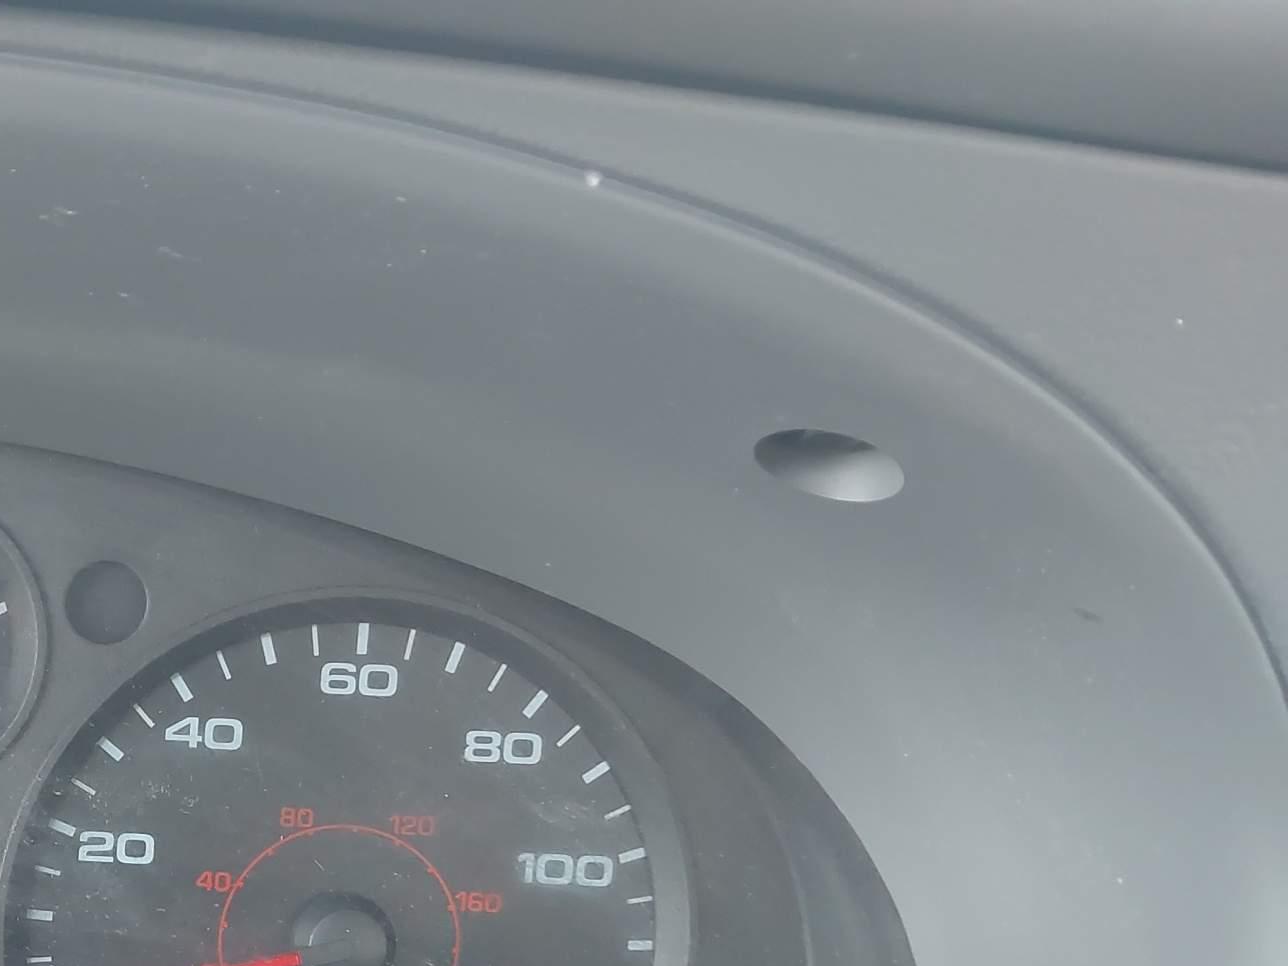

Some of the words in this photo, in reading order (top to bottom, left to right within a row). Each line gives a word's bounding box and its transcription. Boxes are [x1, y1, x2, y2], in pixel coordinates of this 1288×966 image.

[320, 662, 398, 697] 60
[164, 717, 244, 751] 40
[463, 730, 543, 765] 80
[279, 808, 313, 829] 80
[390, 815, 435, 836] 120
[78, 831, 156, 865] 20
[195, 871, 232, 893] 40
[517, 853, 614, 887] 100
[455, 891, 502, 913] 160
